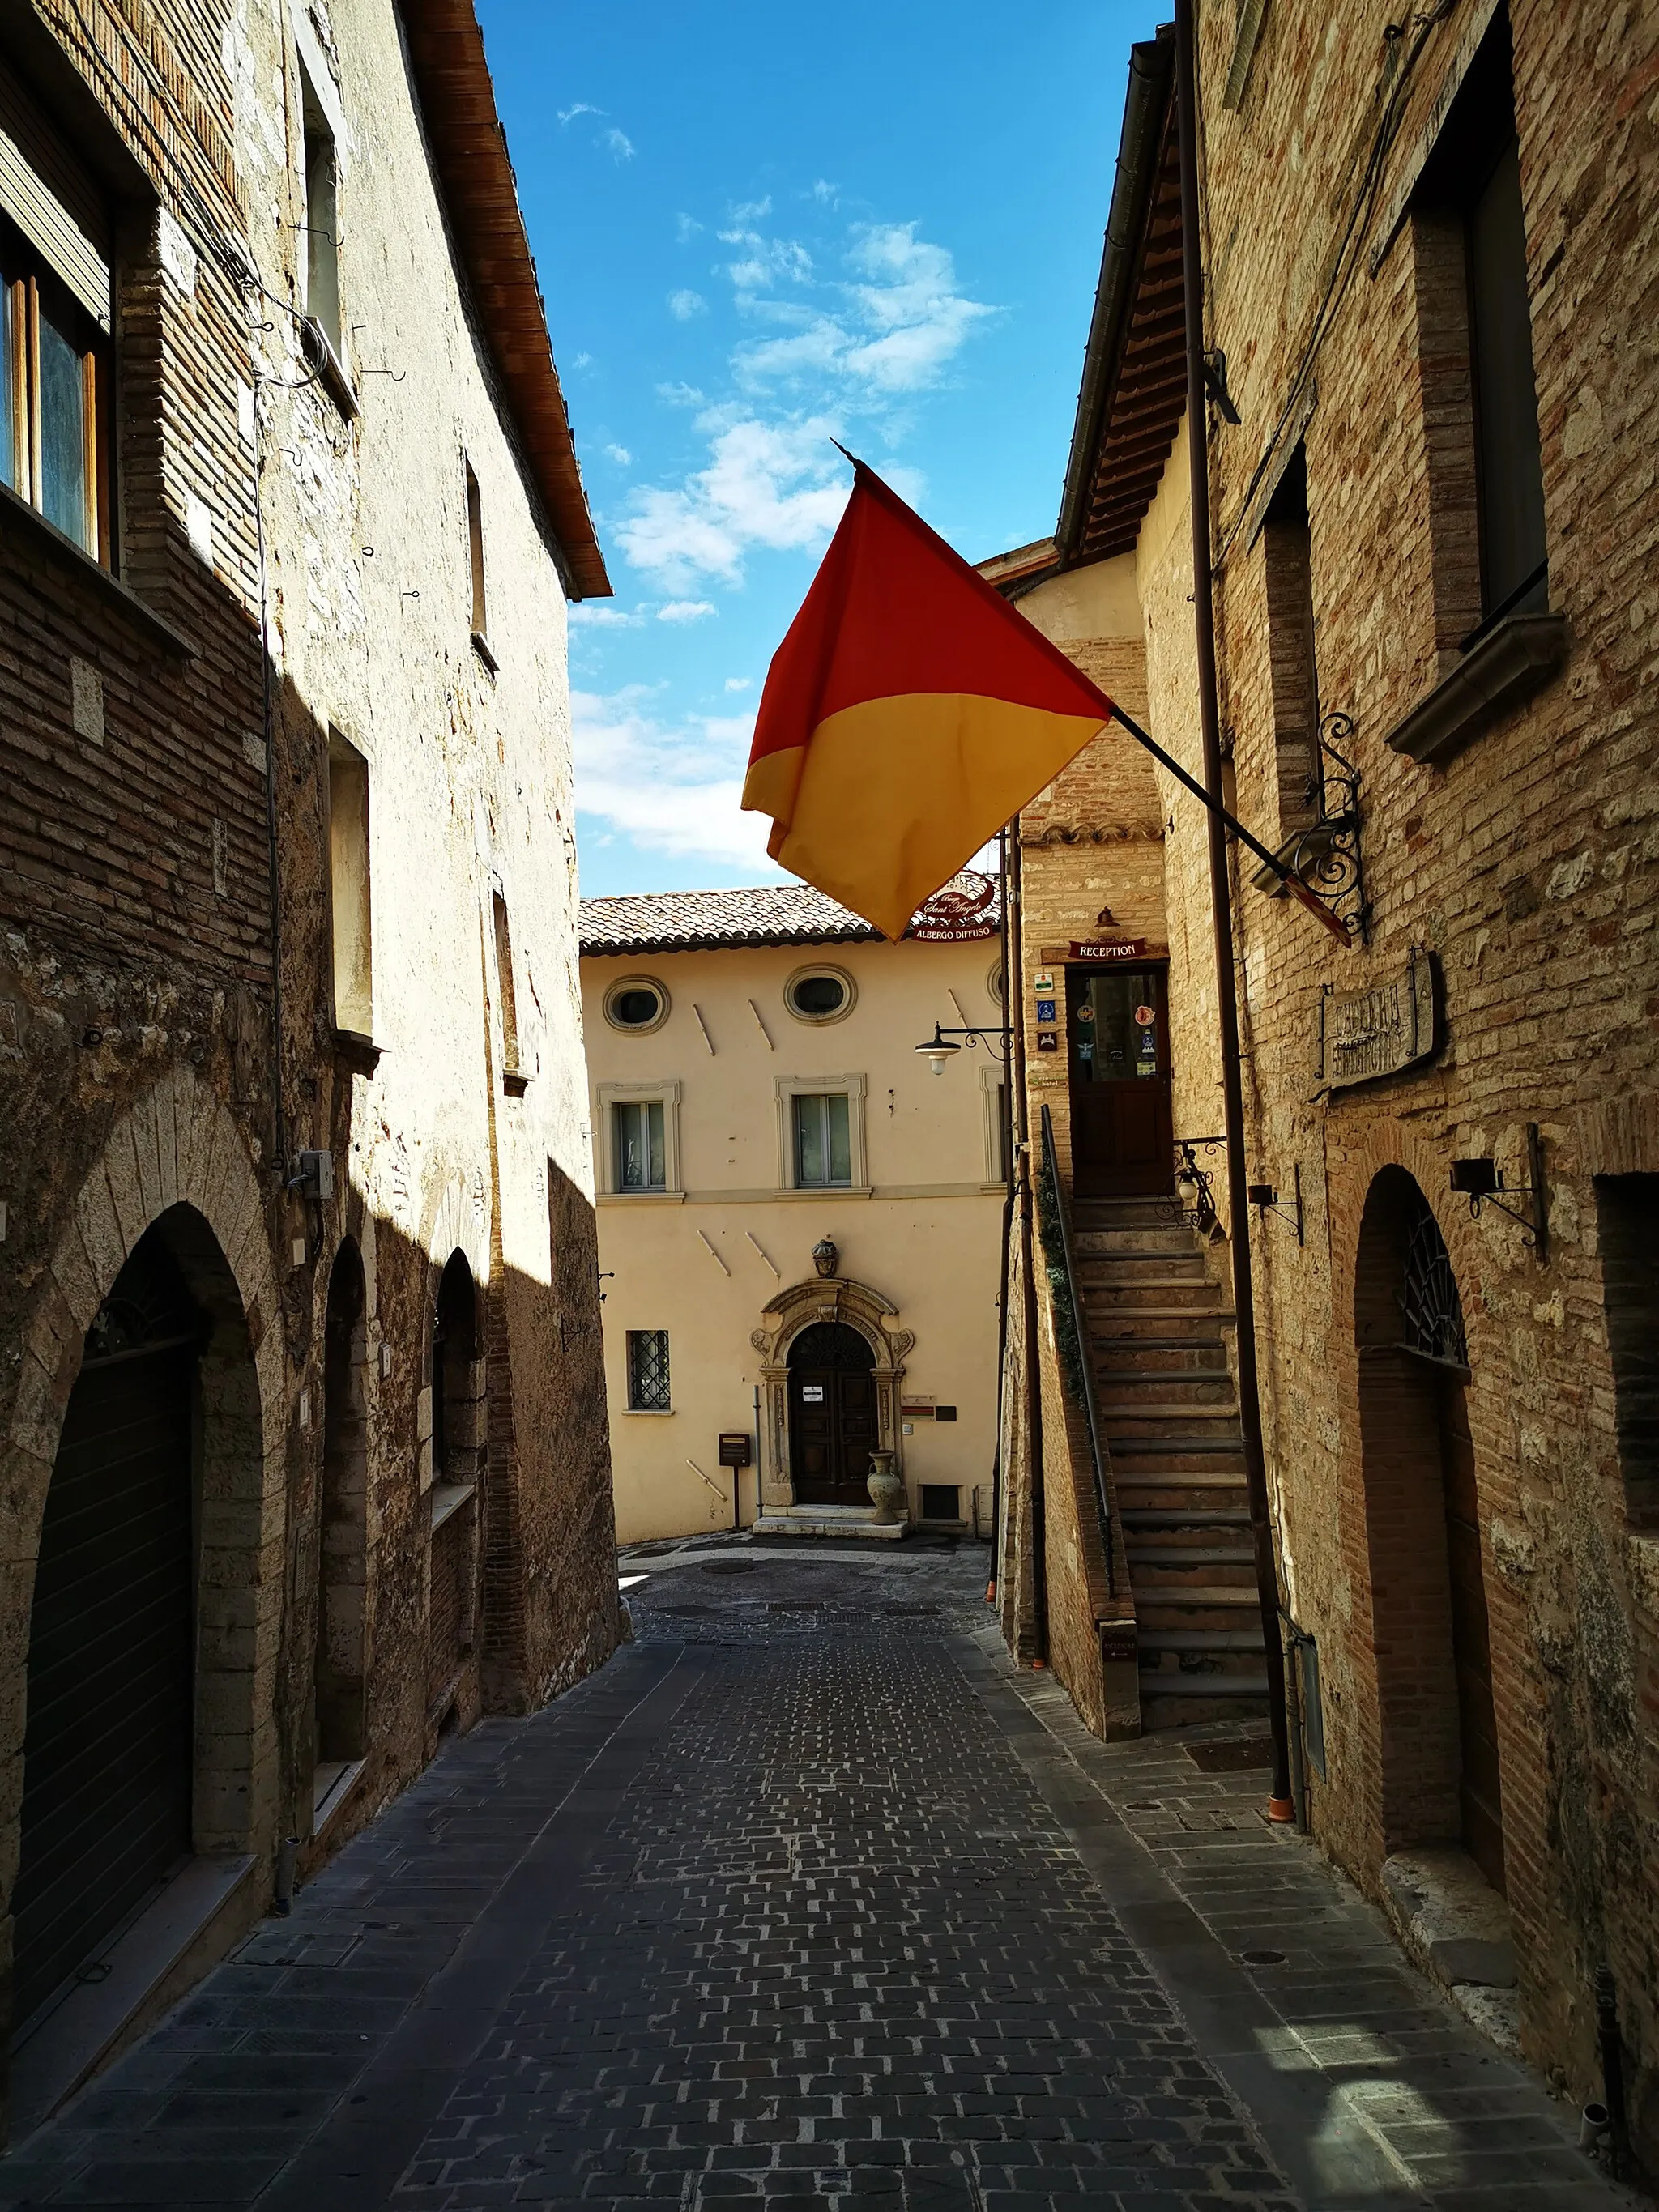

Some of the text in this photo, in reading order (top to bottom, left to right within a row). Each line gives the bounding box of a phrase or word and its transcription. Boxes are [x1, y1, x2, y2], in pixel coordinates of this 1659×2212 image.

[916, 927, 990, 940] ALBERGO DIFFUSO
[1080, 944, 1136, 957] RECEPTION
